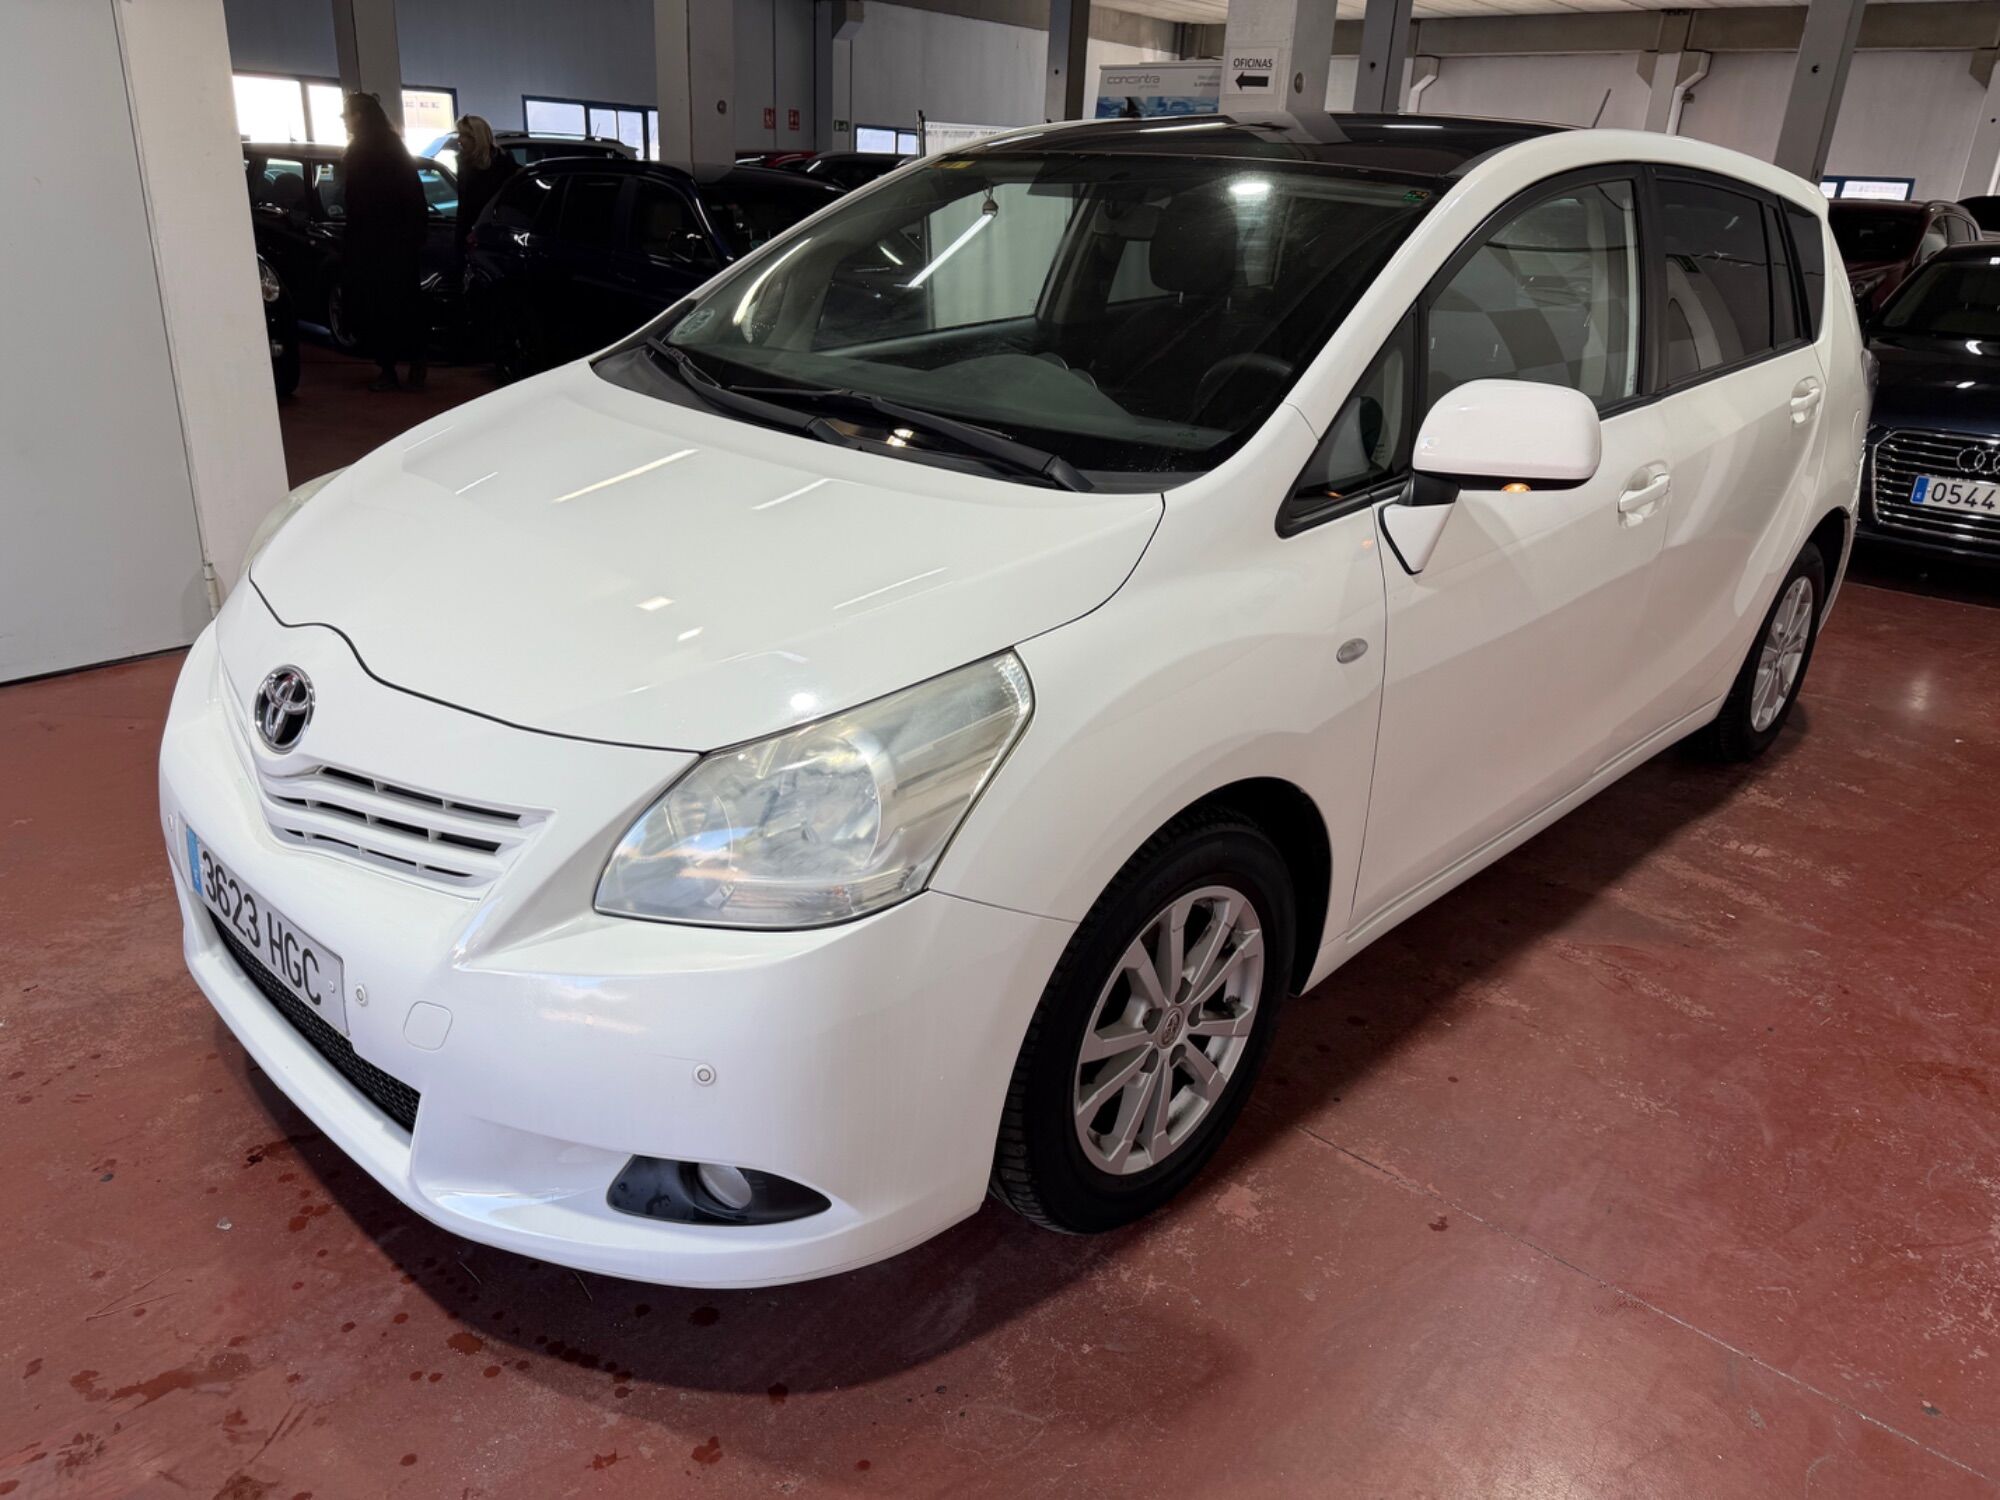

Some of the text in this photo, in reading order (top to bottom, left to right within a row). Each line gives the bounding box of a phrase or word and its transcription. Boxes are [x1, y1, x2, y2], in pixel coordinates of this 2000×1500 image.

[1233, 58, 1273, 68] OFICINAS
[1931, 482, 1996, 510] 0544
[203, 851, 322, 1006] 3623 HGC
